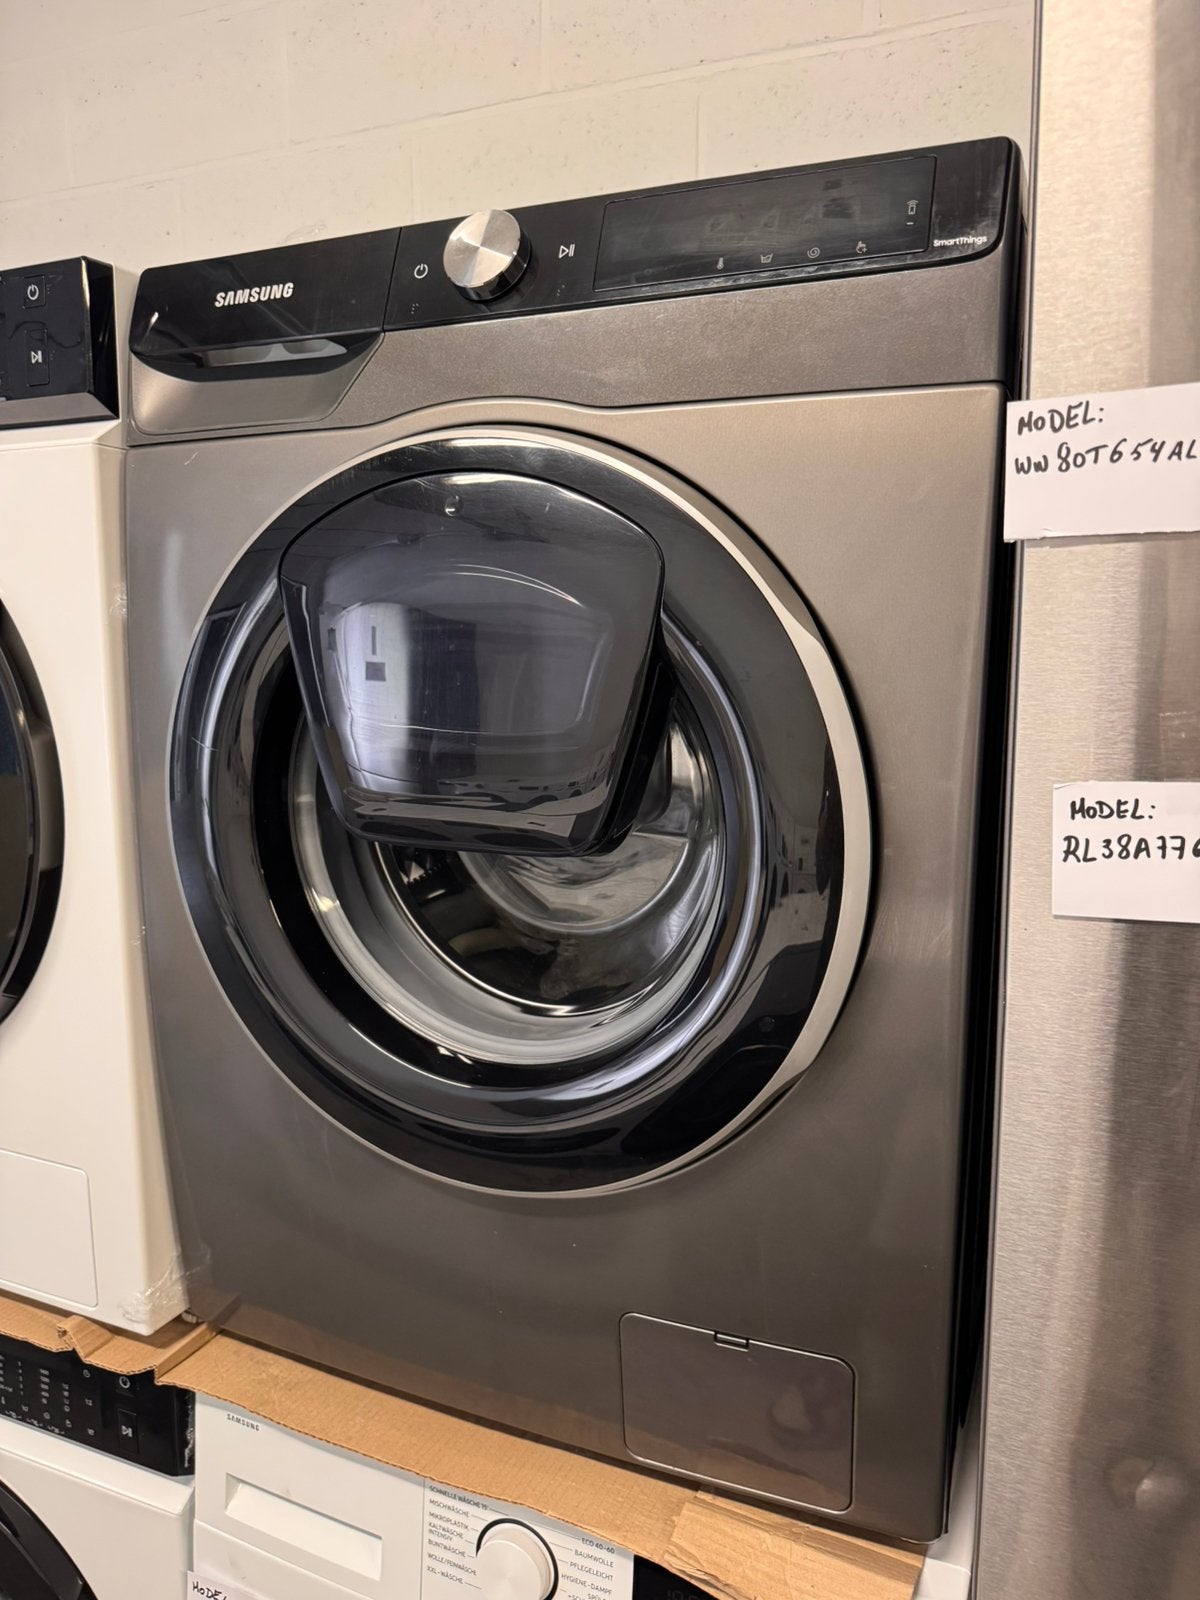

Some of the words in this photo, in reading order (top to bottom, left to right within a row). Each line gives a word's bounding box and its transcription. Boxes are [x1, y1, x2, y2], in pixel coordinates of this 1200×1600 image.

[933, 235, 988, 248] SmartThings
[214, 282, 295, 308] SAMSUNG
[226, 1413, 260, 1432] SAMSUNG
[581, 1537, 595, 1548] ECO
[594, 1542, 616, 1555] 40-60
[574, 1549, 615, 1568] BAUMWOLLE
[569, 1561, 614, 1581] PFLEGELEICHT
[561, 1573, 613, 1595] HYGIENE-DAMPF
